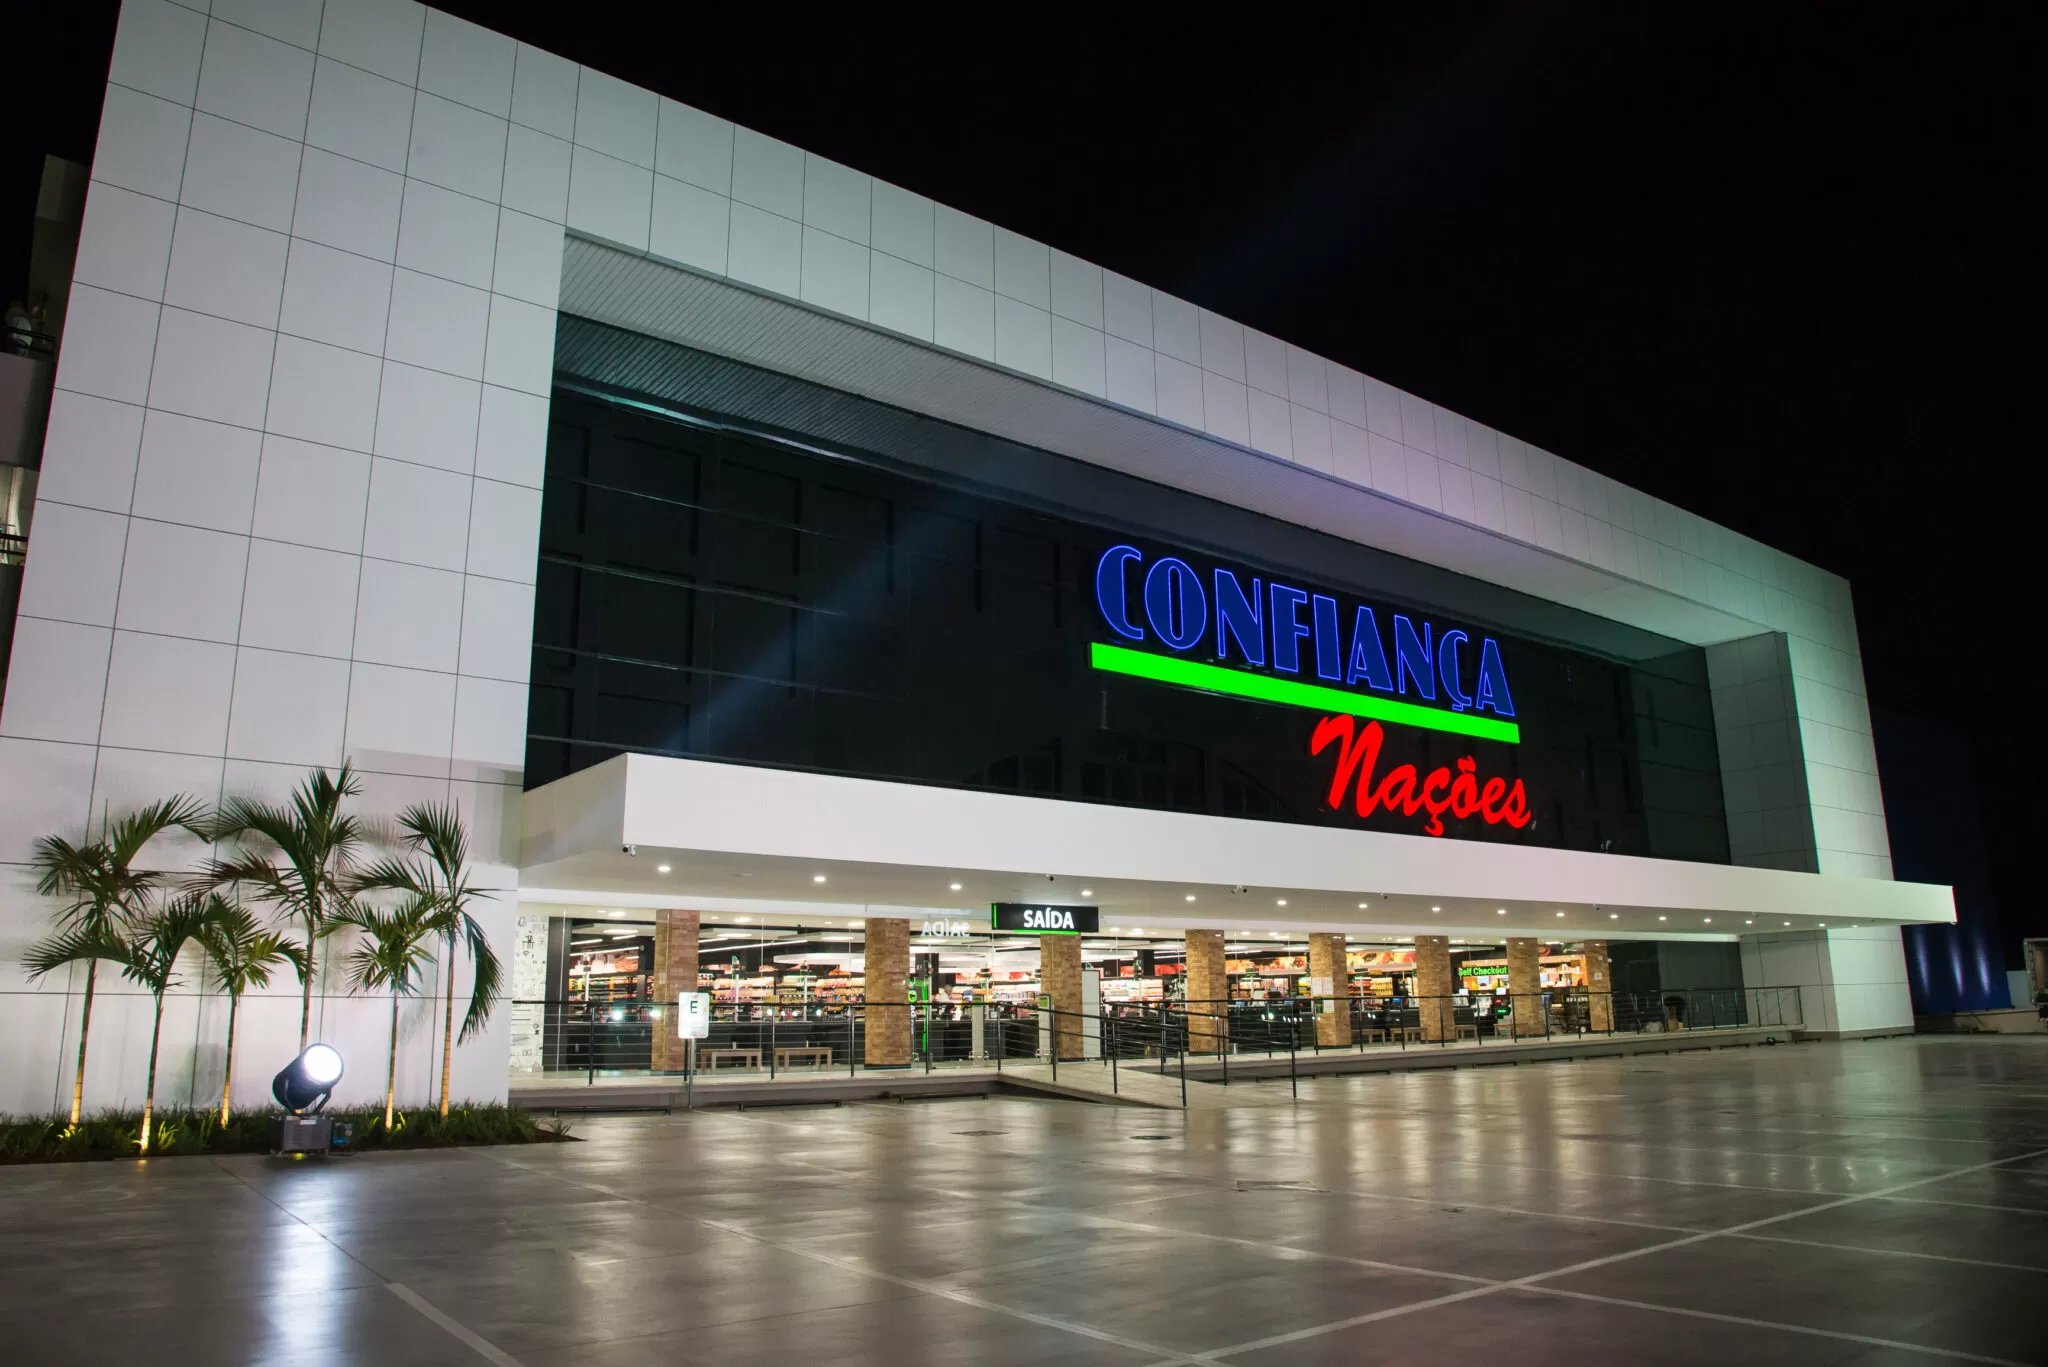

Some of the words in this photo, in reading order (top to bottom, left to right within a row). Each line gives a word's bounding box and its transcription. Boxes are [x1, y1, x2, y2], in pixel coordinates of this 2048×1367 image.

[1096, 545, 1516, 716] CONFIANÇA
[1311, 714, 1532, 836] Nações
[1024, 908, 1075, 929] SAÍDA
[1473, 966, 1508, 976] Checkout
[690, 1000, 698, 1014] E
